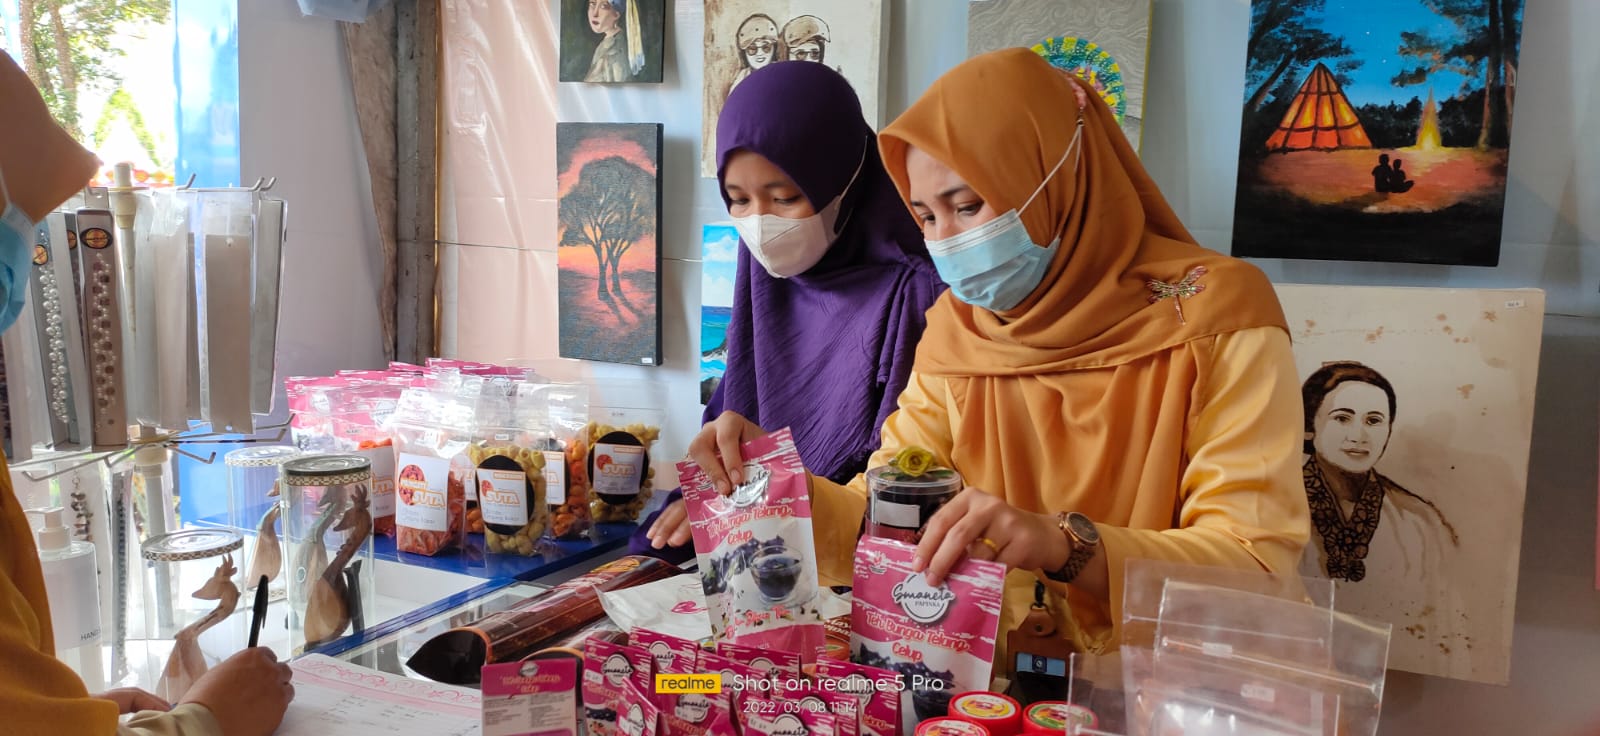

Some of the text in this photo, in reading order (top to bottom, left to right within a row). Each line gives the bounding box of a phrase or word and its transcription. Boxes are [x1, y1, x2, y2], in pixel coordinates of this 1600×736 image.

[485, 490, 520, 506] SUTA
[893, 583, 954, 602] Smaneta
[914, 600, 941, 608] PAPINKA
[866, 611, 885, 629] Teh
[885, 619, 926, 641] Bunga
[926, 630, 971, 653] Telang
[891, 641, 923, 663] Celup
